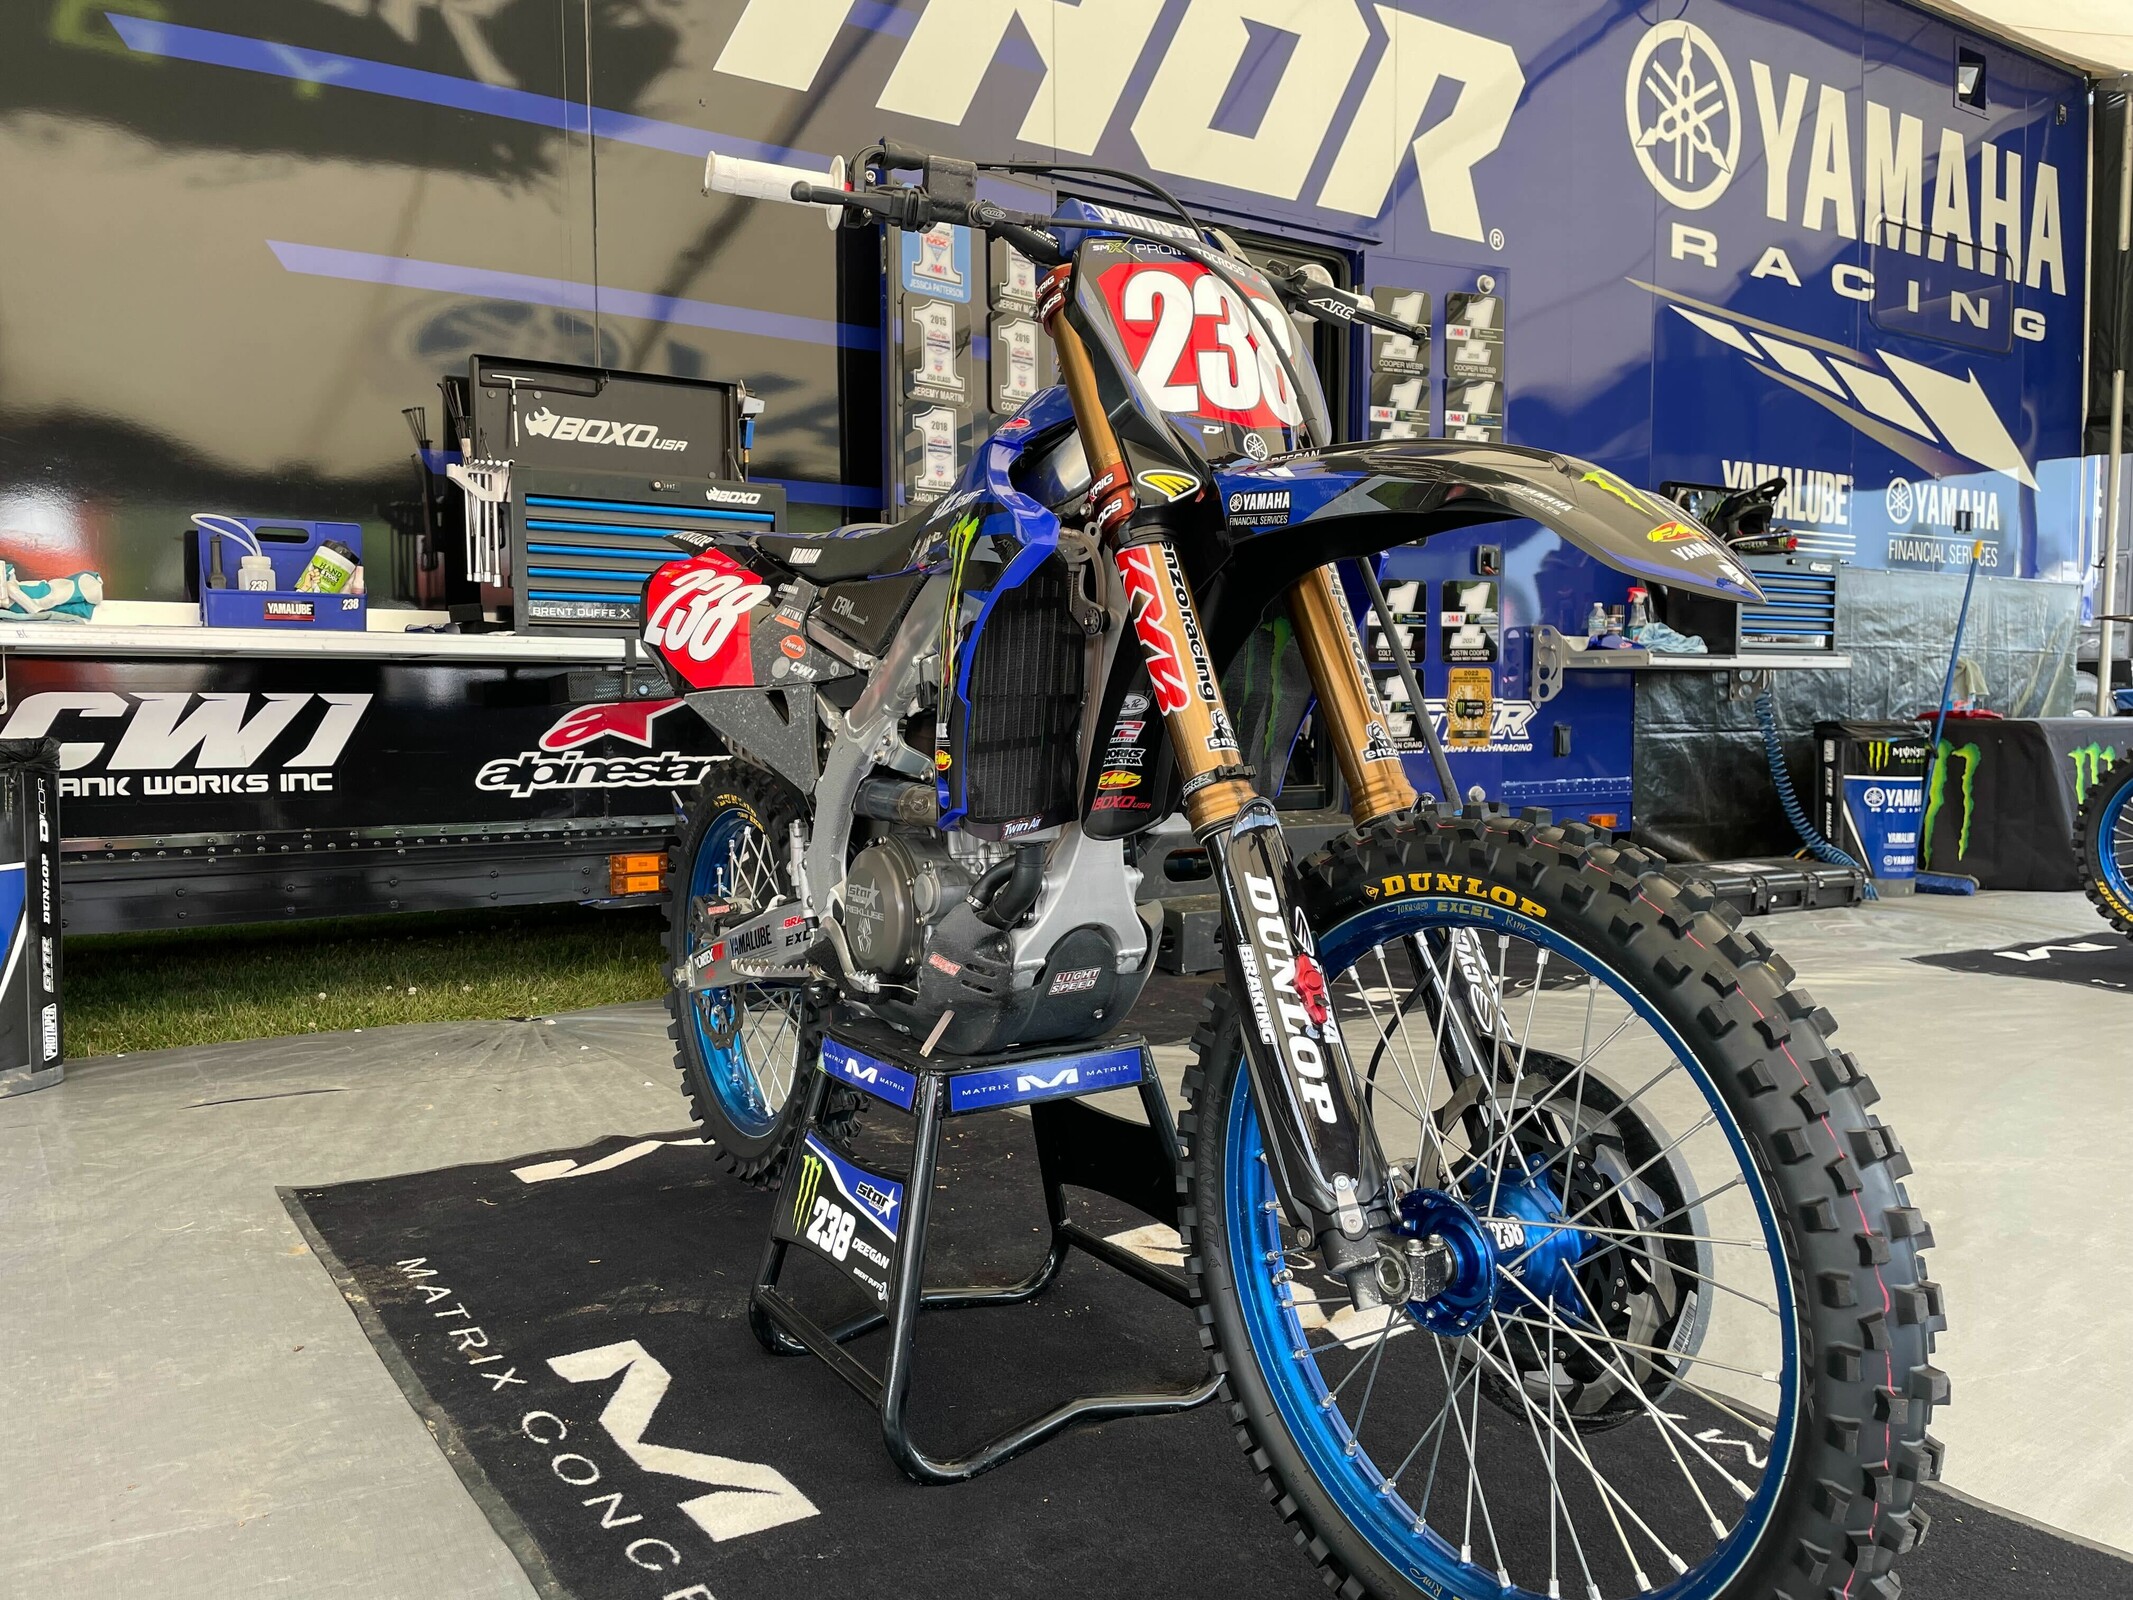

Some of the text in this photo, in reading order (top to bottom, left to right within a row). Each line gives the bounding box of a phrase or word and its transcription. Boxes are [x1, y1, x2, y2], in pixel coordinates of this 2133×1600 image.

[1750, 59, 2066, 296] YAMAHA
[909, 278, 964, 298] JESSICA PATTERSON
[1671, 222, 2046, 342] RACING
[998, 299, 1022, 311] JEREMY
[1309, 297, 1356, 321] ARC
[930, 314, 947, 326] 2015
[1015, 332, 1030, 344] 2016
[1123, 269, 1305, 427] 238
[1379, 359, 1406, 369] COOPER
[1406, 362, 1424, 371] WEBB
[1454, 363, 1478, 373] COOPER
[1479, 365, 1497, 375] WEBB
[913, 386, 965, 403] JEREMY MARTIN
[1001, 402, 1020, 412] COOP
[552, 416, 689, 452] BOXO USA
[931, 420, 948, 432] 2018
[715, 491, 761, 505] BOXO
[913, 492, 934, 503] AARON
[1243, 491, 1291, 510] YAMAHA
[1519, 484, 1574, 512] YAMAHA
[1915, 482, 1999, 532] YAMAHA
[1097, 498, 1123, 524] OCS
[1229, 514, 1288, 527] FINANCIAL SERVICES
[673, 530, 715, 548] DUNLOP
[788, 547, 822, 564] YAMAHA
[1888, 540, 1998, 569] FINANCIAL SERVCES
[319, 561, 342, 579] HAND
[250, 580, 268, 591] 238
[267, 602, 314, 616] YAMALUBE
[342, 598, 359, 611] 238
[532, 606, 616, 618] BRENT DUFFE
[643, 568, 772, 662] 238
[1159, 540, 1218, 703] enzoracing
[1115, 543, 1191, 717] KYB
[1449, 649, 1490, 657] JUSTIN COOPER
[1403, 741, 1423, 749] CRAIG
[59, 772, 333, 797] ANK WORKS INC
[475, 751, 733, 798] alpinestar
[1099, 773, 1142, 786] FMF
[1092, 795, 1152, 811] BOXO USA
[1885, 788, 1922, 807] YAMA
[1870, 806, 1922, 814] RACIN
[1004, 821, 1028, 837] Twin
[1028, 817, 1042, 832] Air
[42, 853, 51, 925] DUNLOP
[847, 884, 873, 899] star
[1381, 871, 1548, 919] DUNLOP
[782, 914, 806, 930] BRA
[846, 905, 885, 922] REKLUSE
[1437, 902, 1495, 919] EXCEL
[1503, 913, 1536, 935] Rim
[729, 924, 773, 957] YAMALUBE
[1055, 967, 1100, 983] LIGHT
[1050, 979, 1096, 994] SPEED
[1238, 944, 1277, 1045] BRAKING
[1244, 871, 1338, 1125] DUNLOP
[43, 1004, 57, 1060] PROTAPER
[823, 1051, 845, 1065] MATRIX
[879, 1076, 906, 1093] MATRIX
[961, 1083, 1010, 1096] MATRIX
[1086, 1064, 1129, 1077] MATRIX
[1200, 1084, 1221, 1248] DUNLOP
[856, 1181, 890, 1207] star
[806, 1195, 857, 1263] 238
[1490, 1215, 1525, 1250] 238
[851, 1237, 890, 1270] DEEGAN
[853, 1267, 884, 1292] BRENT DUFFE
[396, 1257, 528, 1391] MATRIX
[521, 1410, 717, 1600] CONC
